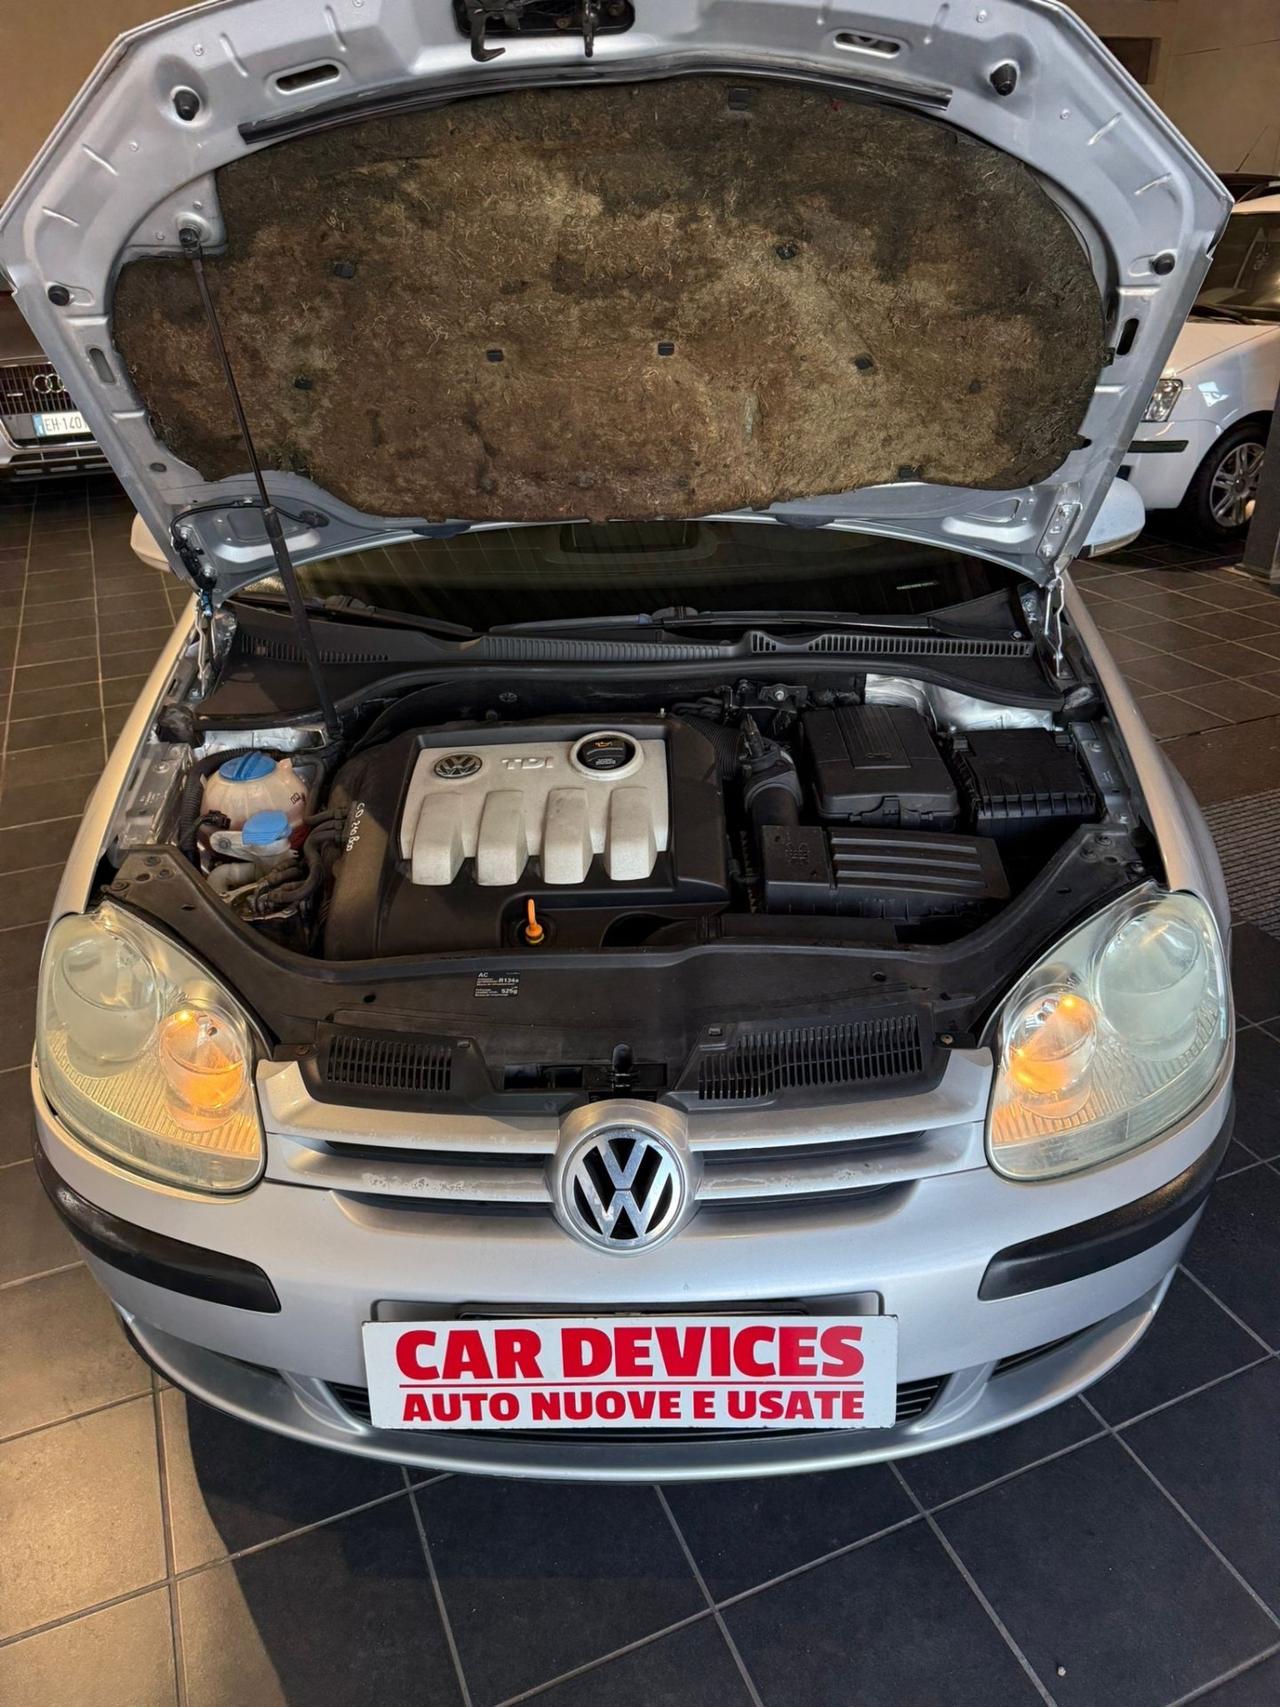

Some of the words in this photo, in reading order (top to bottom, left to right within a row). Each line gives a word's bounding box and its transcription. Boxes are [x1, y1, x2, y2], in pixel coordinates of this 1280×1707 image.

[502, 756, 554, 770] TDI
[395, 1329, 543, 1381] CAR
[561, 1326, 865, 1379] DEVICES
[402, 1392, 521, 1422] AUTO
[531, 1391, 681, 1421] NUOVE
[693, 1391, 716, 1420] E
[727, 1390, 864, 1420] USATE
